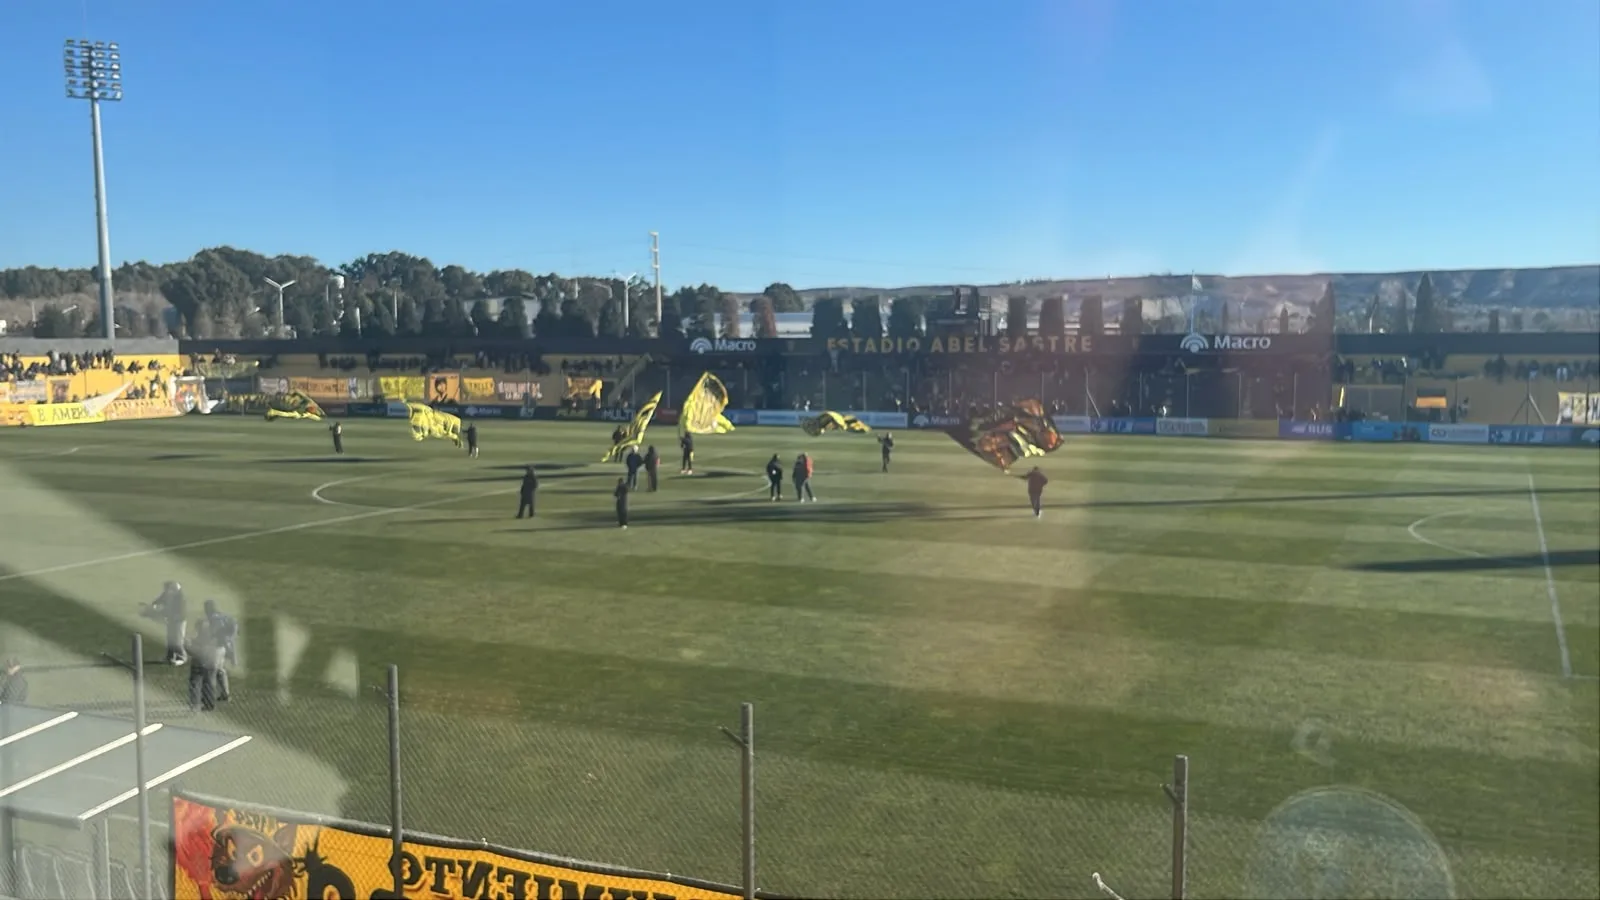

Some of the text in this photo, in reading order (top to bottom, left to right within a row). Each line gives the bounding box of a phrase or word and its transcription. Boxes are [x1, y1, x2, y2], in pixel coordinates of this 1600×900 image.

[714, 338, 756, 351] Macro
[827, 336, 1093, 353] ESTADIO ABEL SASTRE
[1214, 335, 1271, 350] Macro
